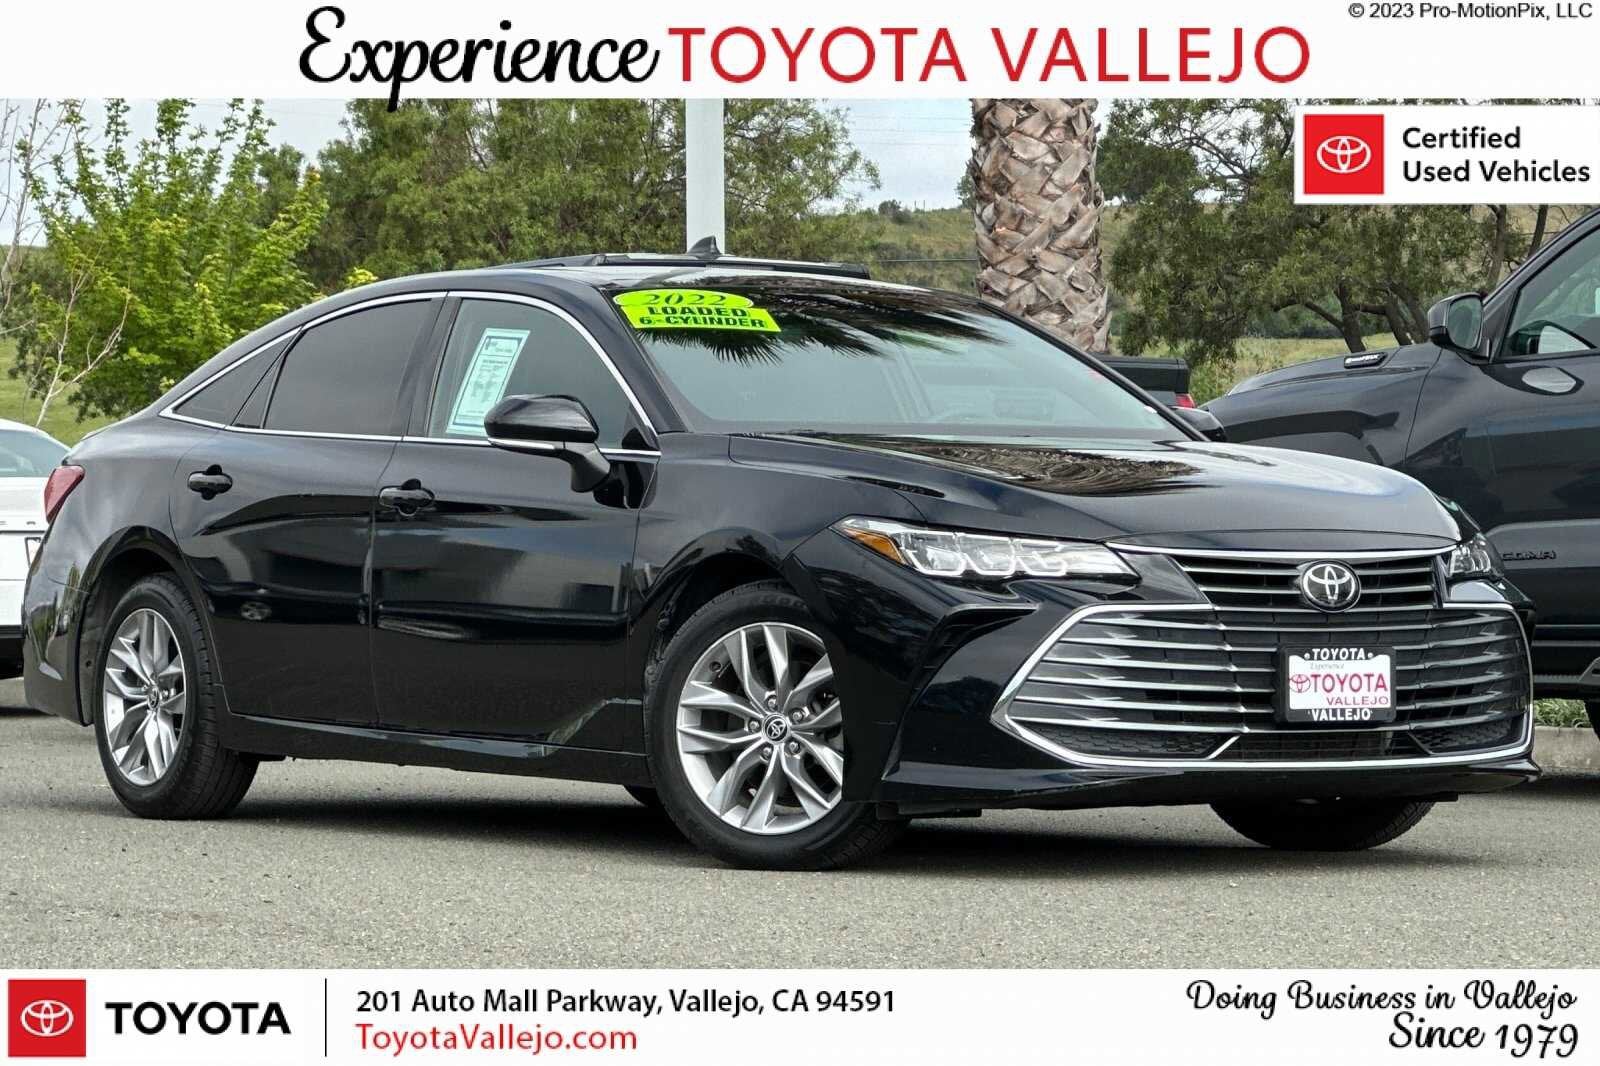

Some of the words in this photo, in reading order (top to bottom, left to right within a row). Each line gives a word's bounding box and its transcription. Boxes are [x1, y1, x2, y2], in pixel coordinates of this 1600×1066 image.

[640, 293, 727, 306] 2022
[649, 306, 747, 317] LOADED
[639, 316, 765, 328] 6-CYLINDER
[1311, 647, 1366, 661] TOYOTA
[1310, 673, 1389, 693] TOYOTA
[1326, 696, 1389, 706] VALLEJO
[1312, 708, 1371, 721] VALLEJO
